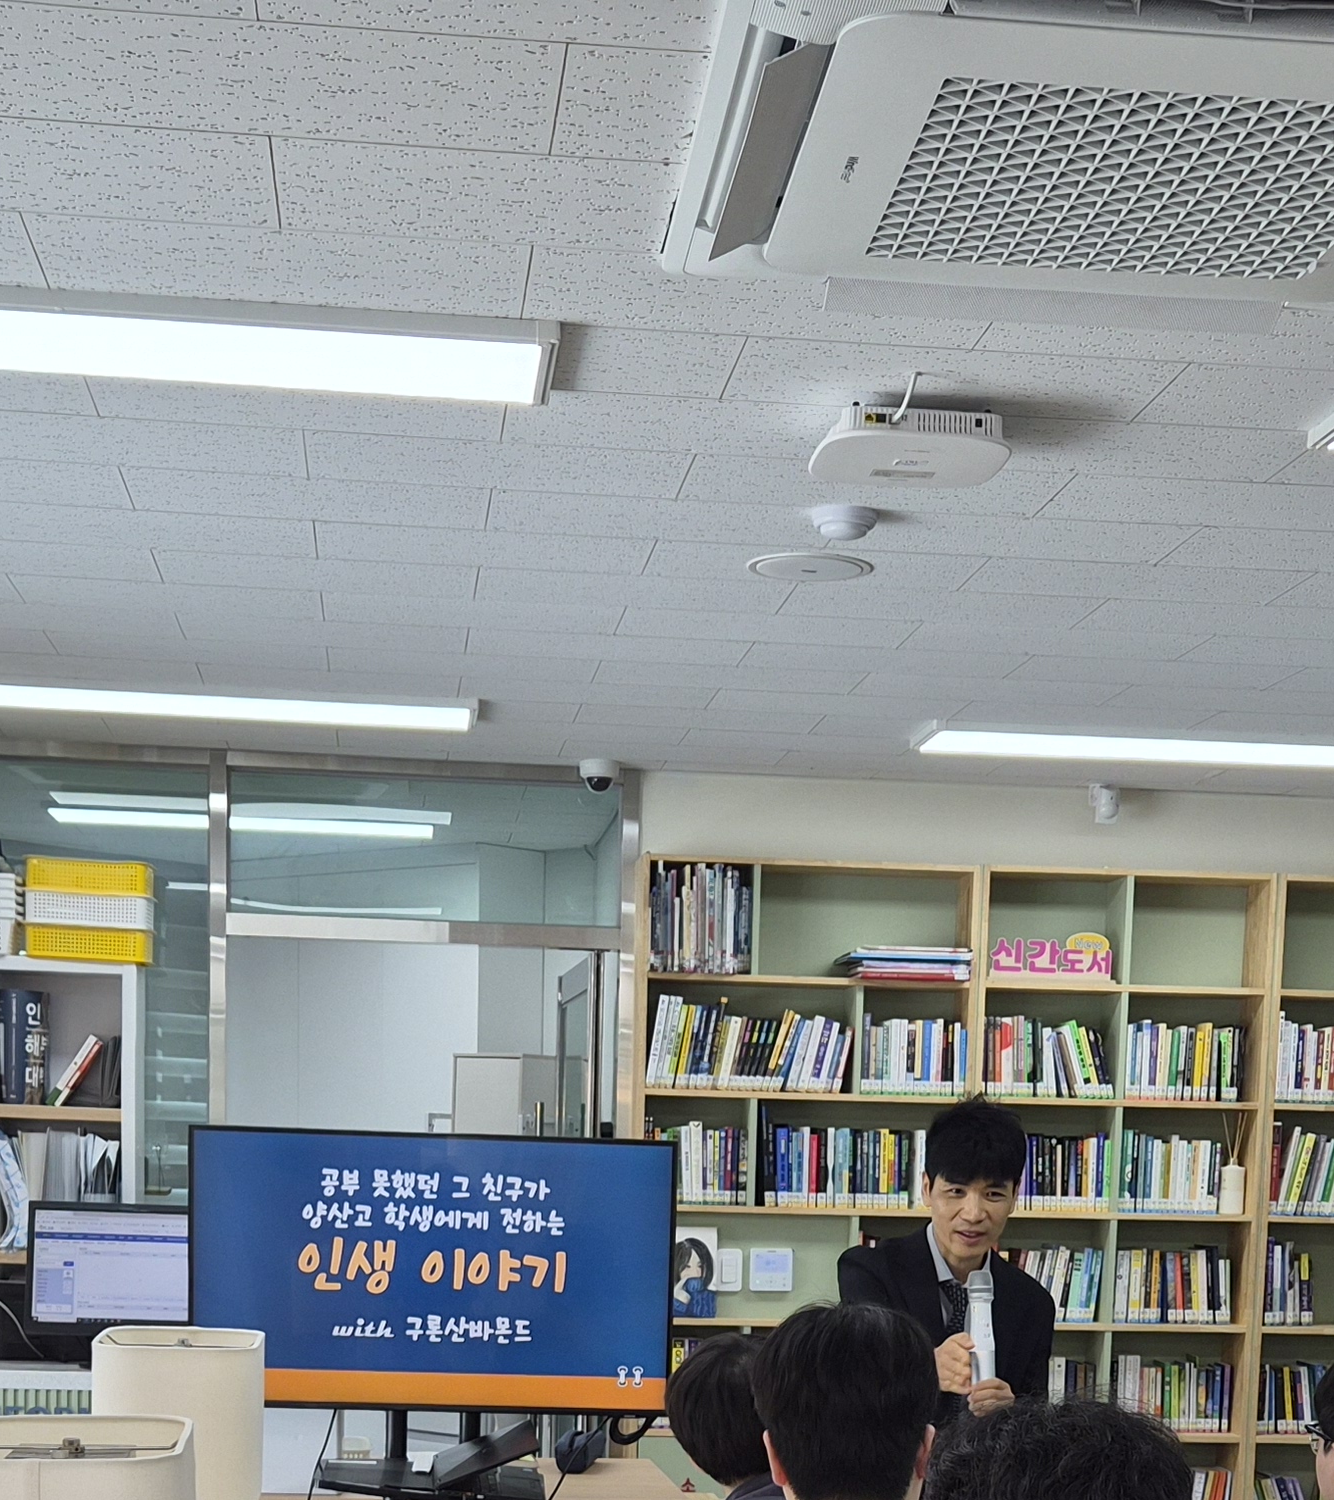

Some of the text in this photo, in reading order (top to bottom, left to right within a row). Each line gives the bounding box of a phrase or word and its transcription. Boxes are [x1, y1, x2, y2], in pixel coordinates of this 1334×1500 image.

[320, 1167, 552, 1202] 공부 못했던 그 친구가
[301, 1200, 566, 1236] 양산고 학생에게 전하는
[296, 1235, 568, 1296] 인생 이야기
[331, 1314, 534, 1345] with 구론산바몬드
